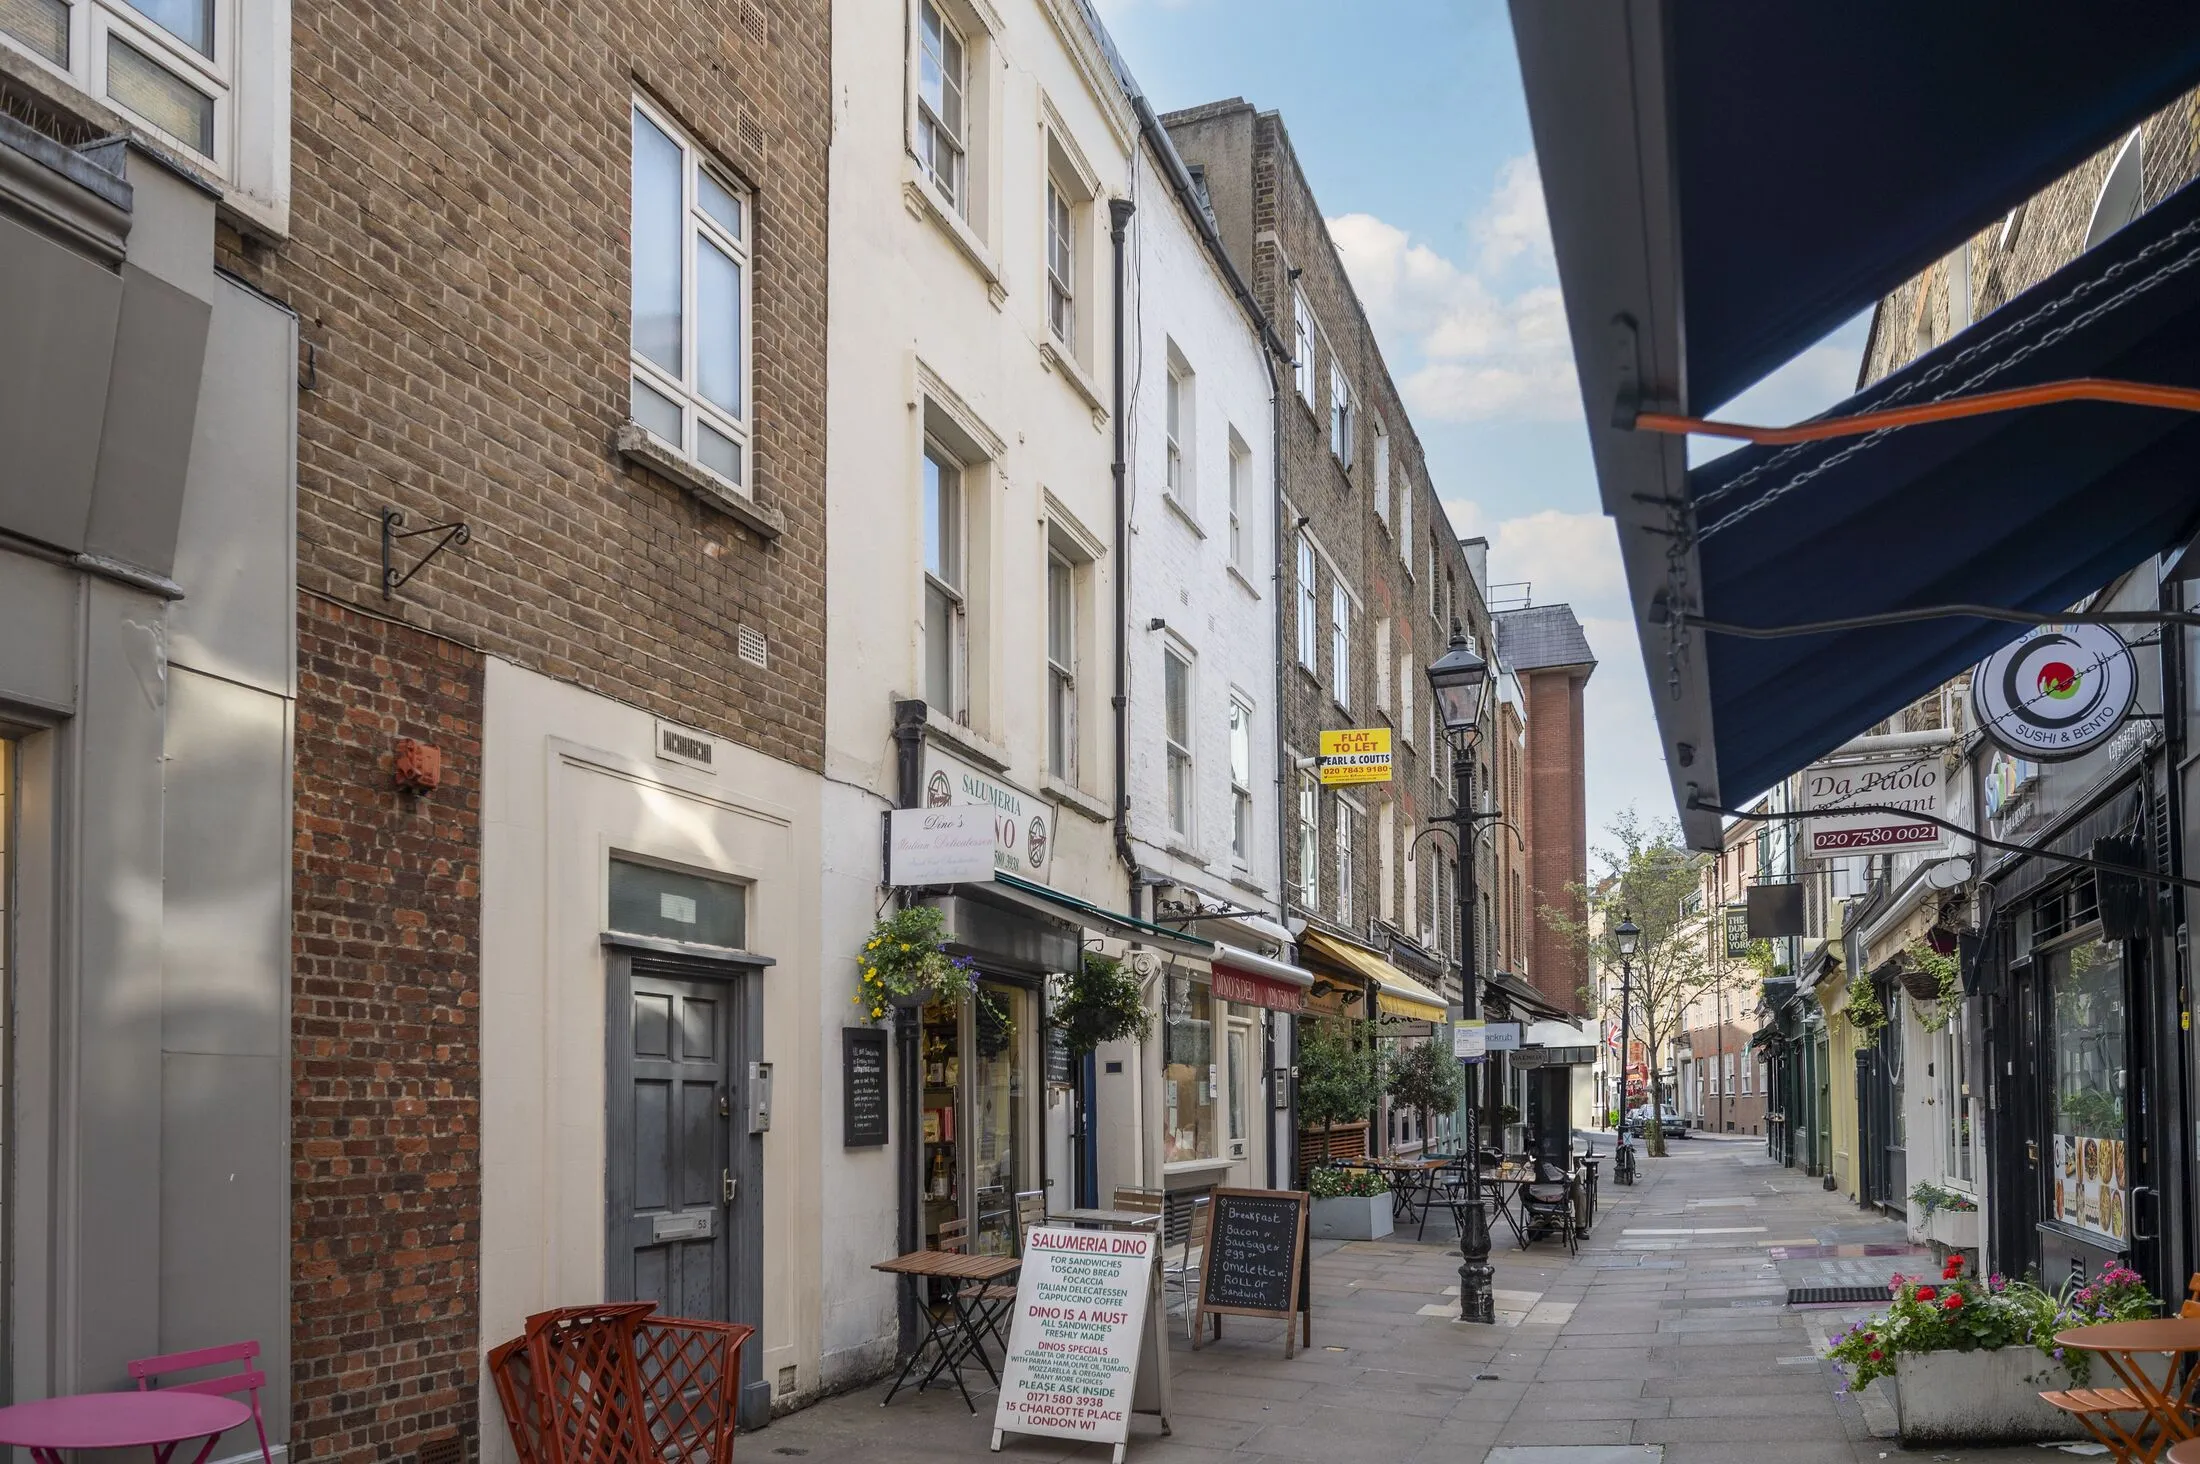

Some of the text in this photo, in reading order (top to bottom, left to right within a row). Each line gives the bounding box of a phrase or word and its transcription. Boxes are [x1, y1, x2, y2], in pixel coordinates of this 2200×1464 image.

[2015, 706, 2114, 744] SUSHI & BENTO
[1341, 732, 1370, 742] FLAT
[1333, 742, 1378, 753] TO LET
[1349, 755, 1357, 764] &
[1358, 754, 1390, 764] COUTTS
[1324, 765, 1388, 775] 020 7843 9180
[1811, 764, 1936, 797] Da Paolo
[962, 774, 1021, 817] SALUMERIA
[1815, 826, 1937, 847] 020 7580 0021
[1005, 854, 1020, 871] 3938
[1728, 916, 1745, 924] THE
[1728, 924, 1748, 933] DUK
[1728, 933, 1740, 941] OF
[1729, 941, 1751, 950] YORK
[1485, 1033, 1513, 1041] ackrub
[1228, 1207, 1280, 1224] Breakfast
[698, 1219, 707, 1229] 53
[1227, 1224, 1259, 1237] Bacon
[1031, 1232, 1147, 1255] SALUMERIA DINO
[1225, 1235, 1272, 1254] Sausage
[1050, 1255, 1122, 1268] FOR SANDWICHES
[1051, 1265, 1120, 1278] TOSCANO BREAD
[1222, 1261, 1276, 1277] Omelette
[1063, 1275, 1104, 1286] FOCACCIA
[1036, 1282, 1128, 1297] ITALIAN DELECATESSEN
[1221, 1286, 1266, 1301] Sandwich
[1038, 1292, 1123, 1306] CAPPUCCINO COFFEE
[1029, 1305, 1128, 1325] DINO IS A MUST
[1058, 1321, 1112, 1332] SANDWICHES
[1045, 1329, 1105, 1342] FRESHLY MADE
[1038, 1341, 1108, 1355] DINOS SPECIALS
[1025, 1350, 1054, 1358] CIABATTA
[1066, 1354, 1098, 1362] FOCACCIA
[1100, 1356, 1120, 1364] FILLED
[1029, 1357, 1052, 1365] PARMA
[1028, 1365, 1070, 1374] MOZZARELLA
[1079, 1370, 1111, 1379] OREGANO
[1075, 1377, 1103, 1386] CHOICES
[1019, 1380, 1115, 1398] PLEASE ASK INSIDE
[1027, 1392, 1103, 1407] 0171 580 3938
[1006, 1402, 1122, 1421] 15 CHARLOTTE PLACE
[1027, 1415, 1096, 1430] LONDON W1
